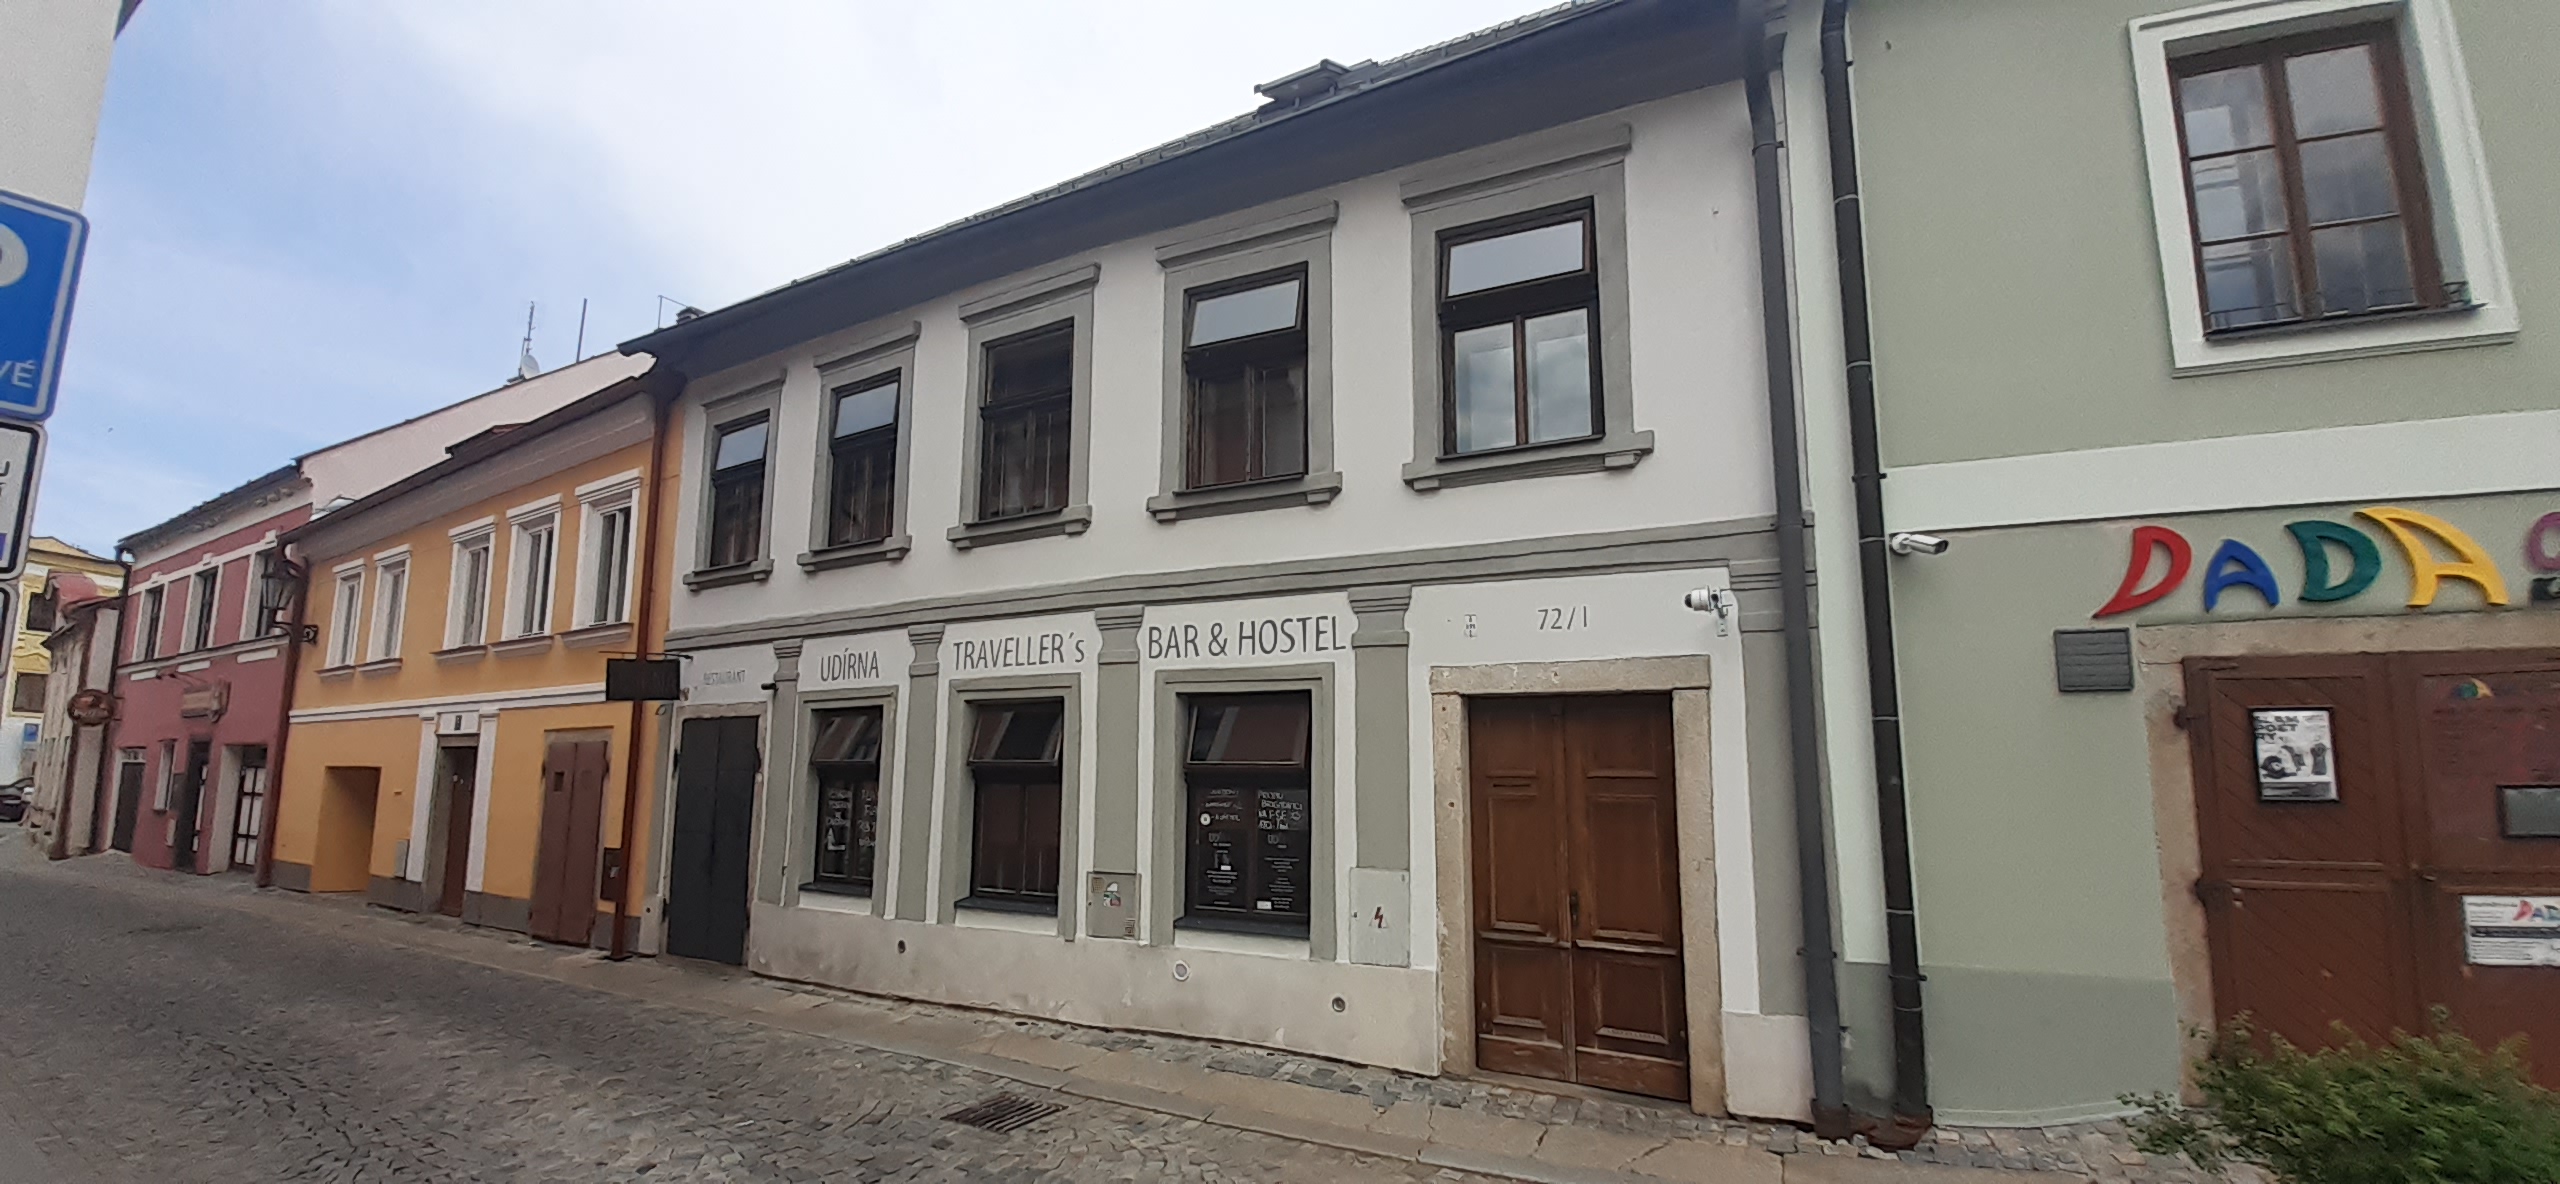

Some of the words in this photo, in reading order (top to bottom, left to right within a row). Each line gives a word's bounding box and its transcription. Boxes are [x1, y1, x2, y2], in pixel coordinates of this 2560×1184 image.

[2092, 506, 2510, 619] DADA
[1147, 622, 1199, 659] BAR
[1207, 622, 1229, 656] &
[1238, 615, 1347, 656] HOSTEL
[820, 647, 880, 682] UDÍRNA
